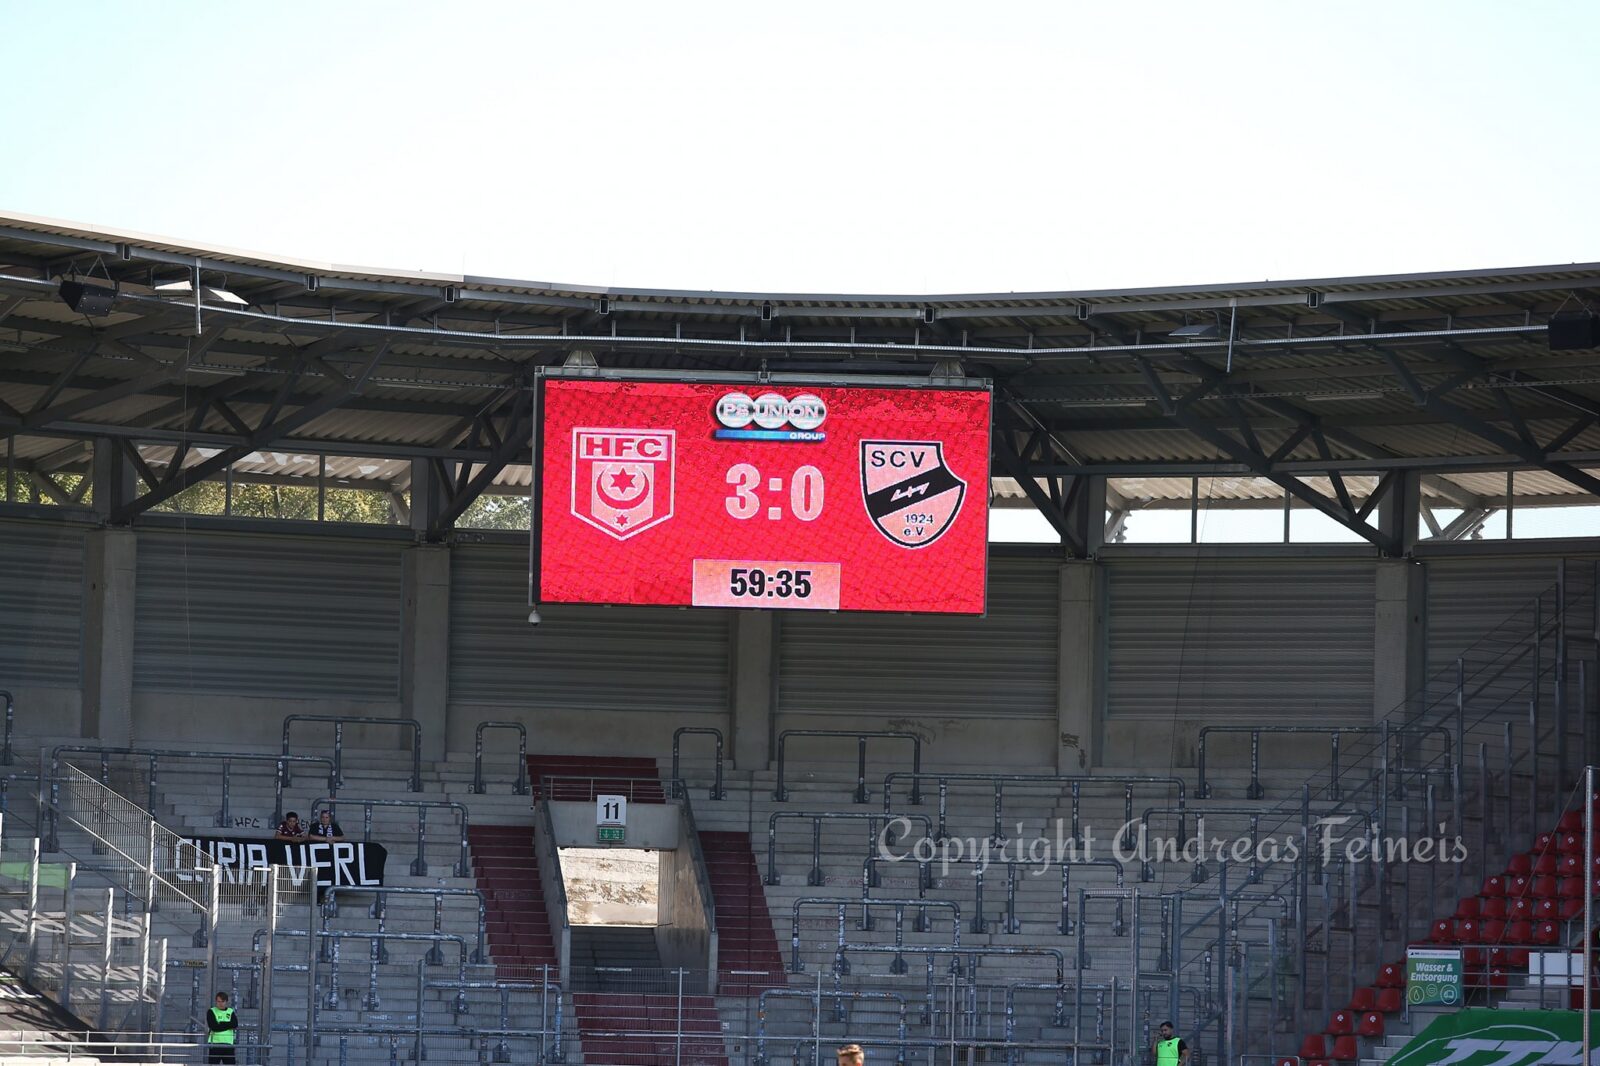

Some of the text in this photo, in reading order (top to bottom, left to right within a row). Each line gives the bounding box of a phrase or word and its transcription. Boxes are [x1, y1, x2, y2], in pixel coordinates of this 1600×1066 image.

[754, 404, 819, 418] UNION
[789, 432, 826, 440] GROUP
[585, 437, 662, 457] HFC
[871, 450, 925, 467] SCV
[725, 463, 825, 521] 3:0
[905, 513, 933, 523] 1924
[730, 568, 812, 598] 59:35
[603, 802, 619, 819] 11
[284, 842, 380, 886] VERL
[1415, 962, 1453, 972] Wasser &
[1410, 972, 1458, 984] Entsorgung
